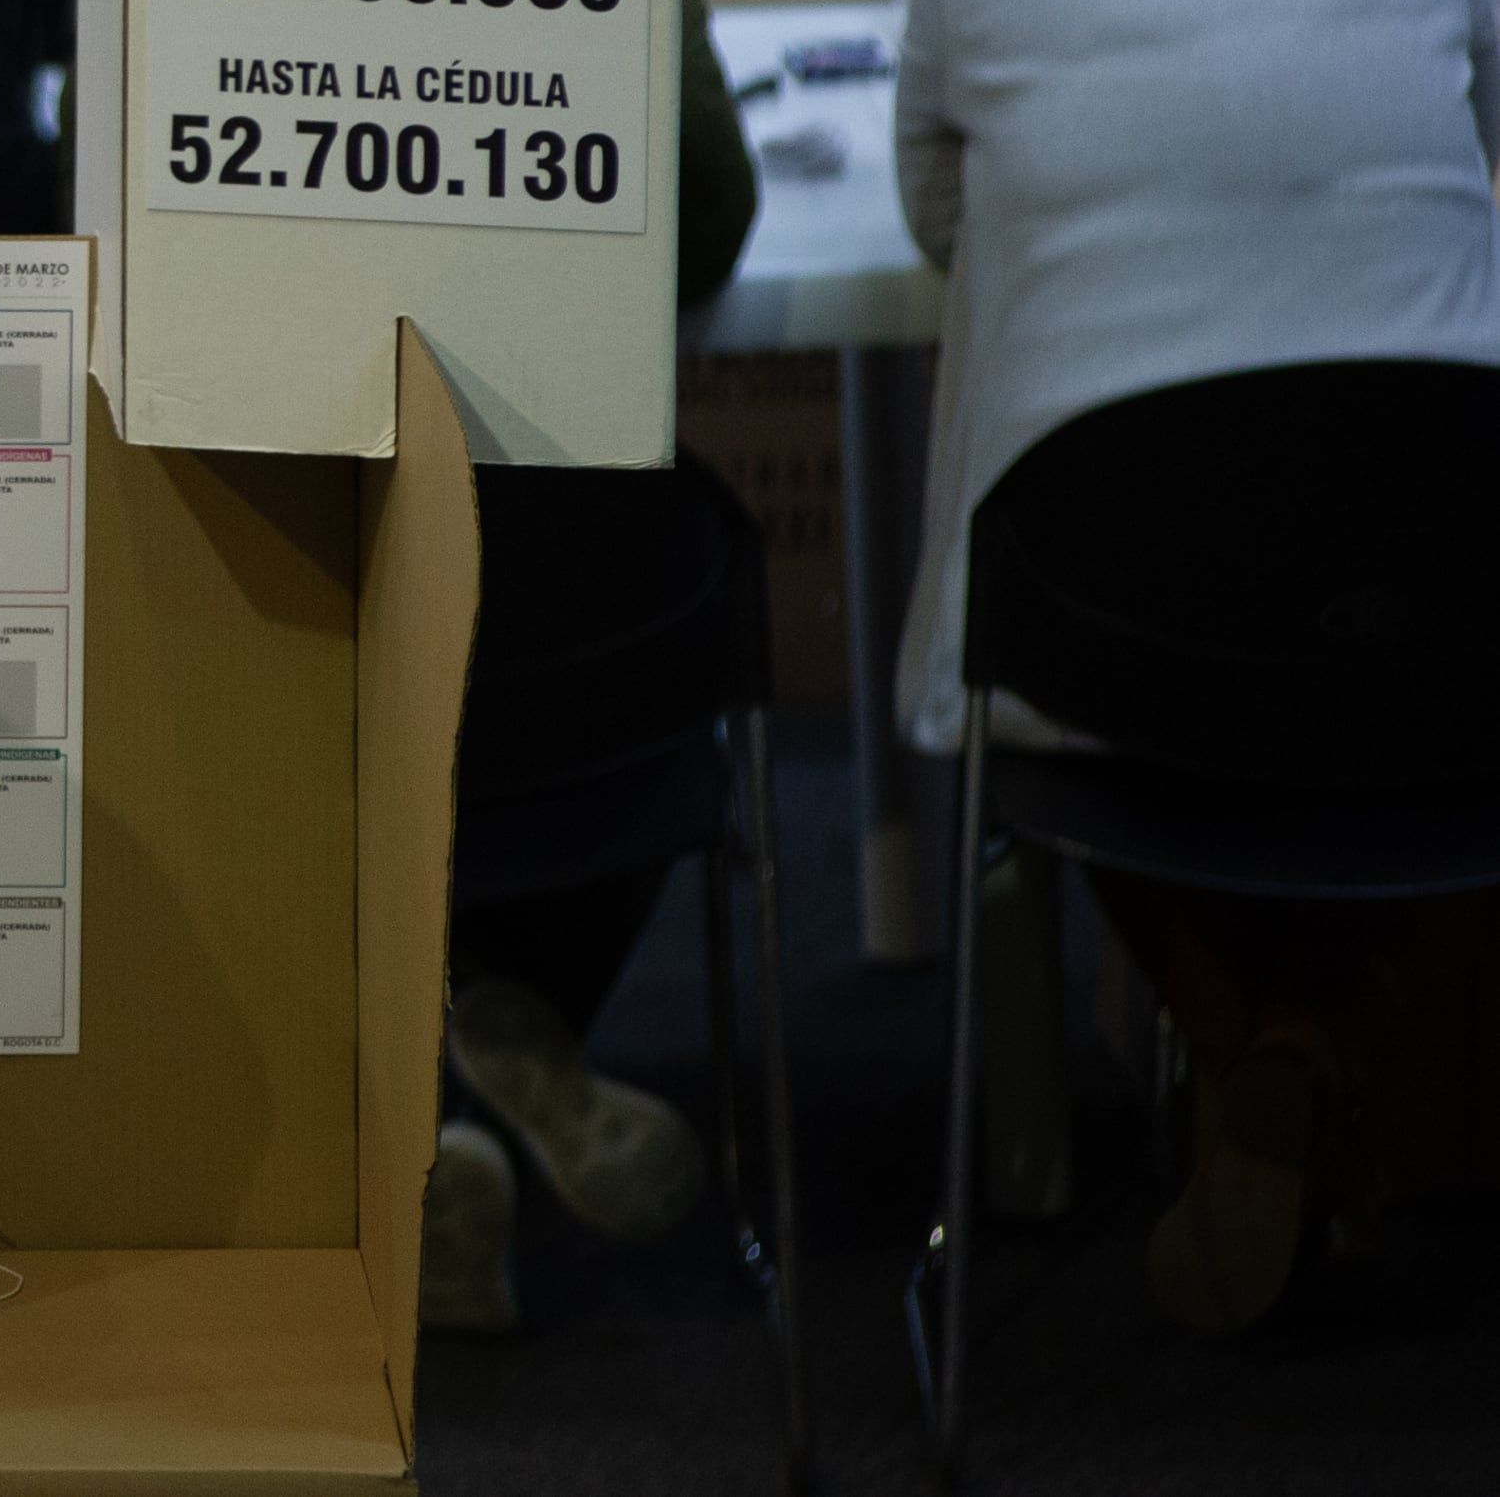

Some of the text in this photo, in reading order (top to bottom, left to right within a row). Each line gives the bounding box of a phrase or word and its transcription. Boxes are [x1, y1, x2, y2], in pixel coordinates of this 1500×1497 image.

[218, 58, 570, 109] HASTA LA CÉDULA
[169, 114, 620, 204] 52.700.130
[16, 263, 70, 276] MARZO
[6, 331, 59, 339] (CERRADA)
